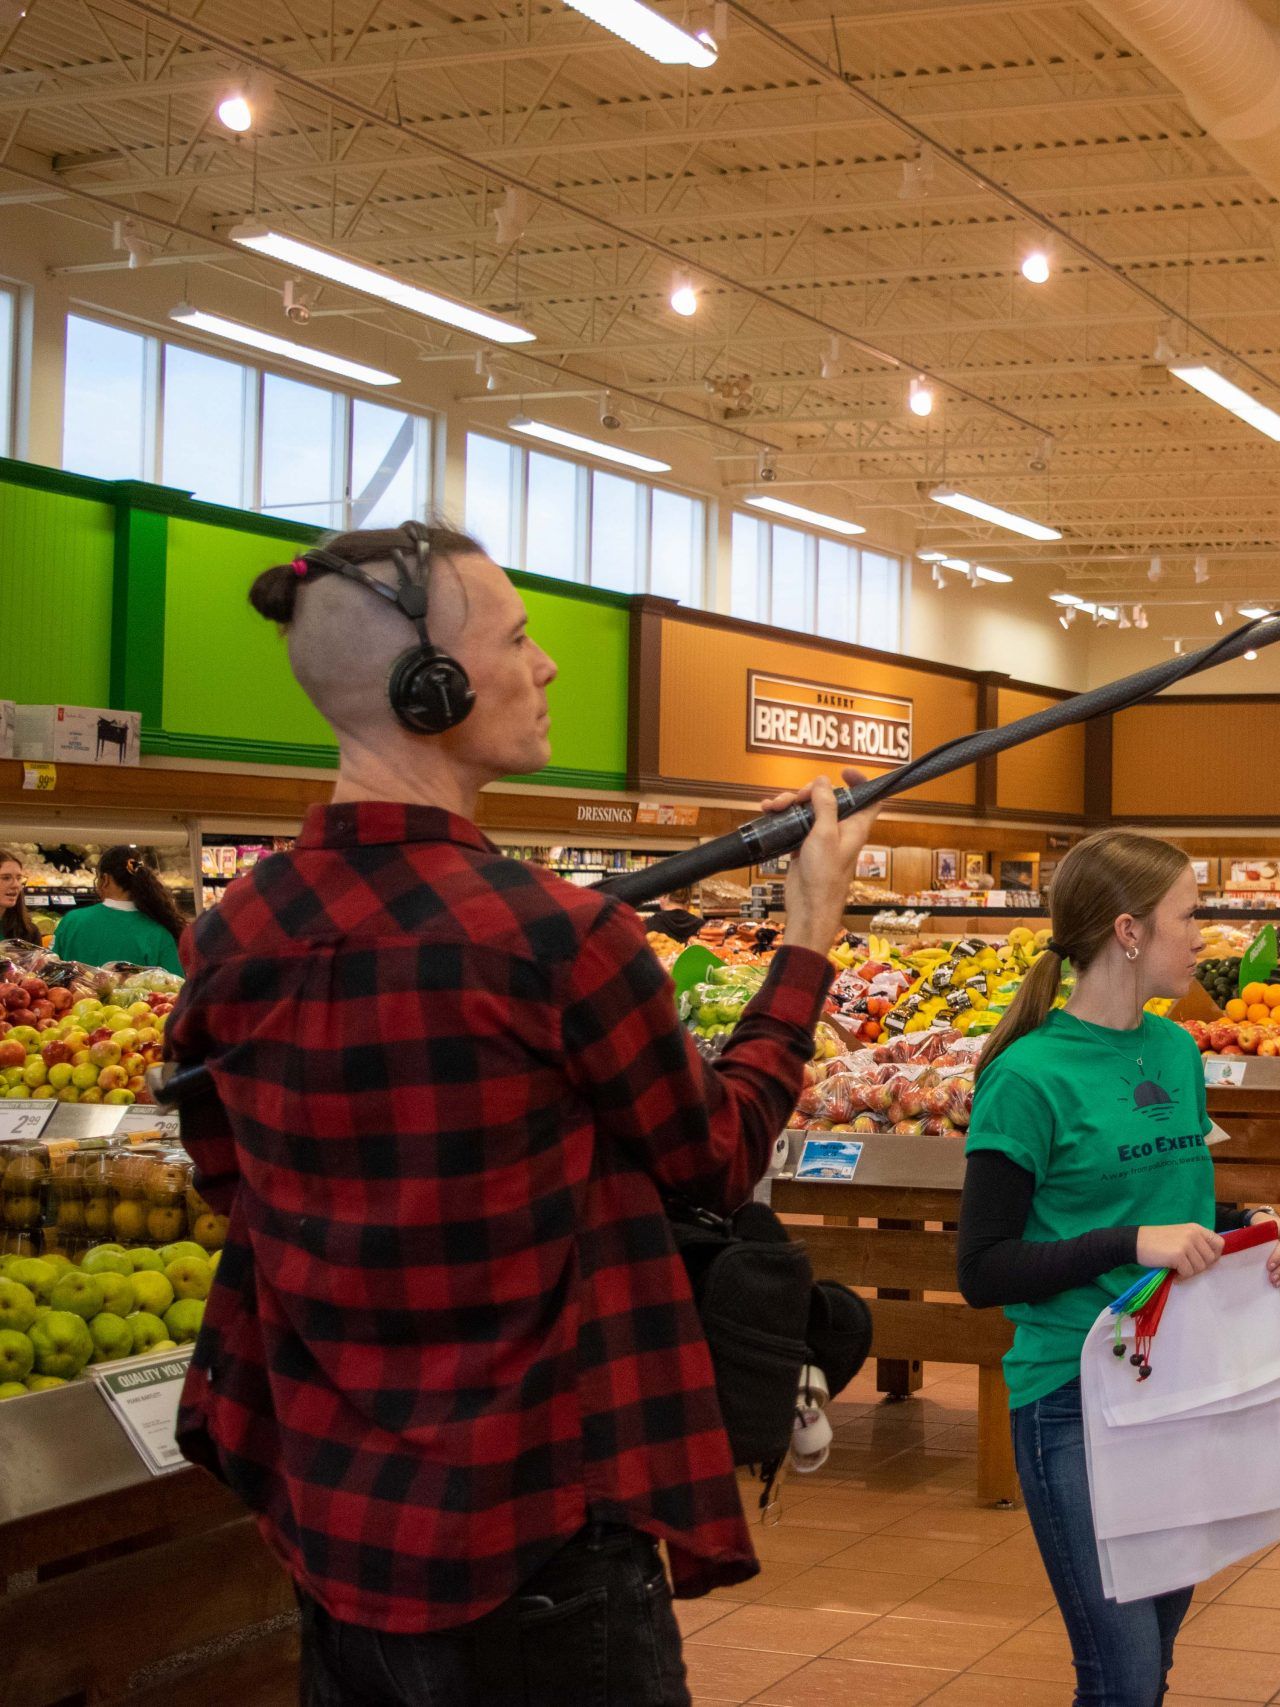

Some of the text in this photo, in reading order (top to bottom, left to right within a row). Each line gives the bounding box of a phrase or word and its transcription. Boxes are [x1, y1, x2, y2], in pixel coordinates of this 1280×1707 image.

[817, 694, 855, 709] BAKERY
[755, 705, 910, 759] BREADS & ROLLS
[577, 806, 633, 823] DRESSINGS
[1100, 1171, 1128, 1182] Away
[1131, 1164, 1149, 1175] from
[117, 1367, 161, 1387] QUALITY
[160, 1363, 184, 1377] YOU
